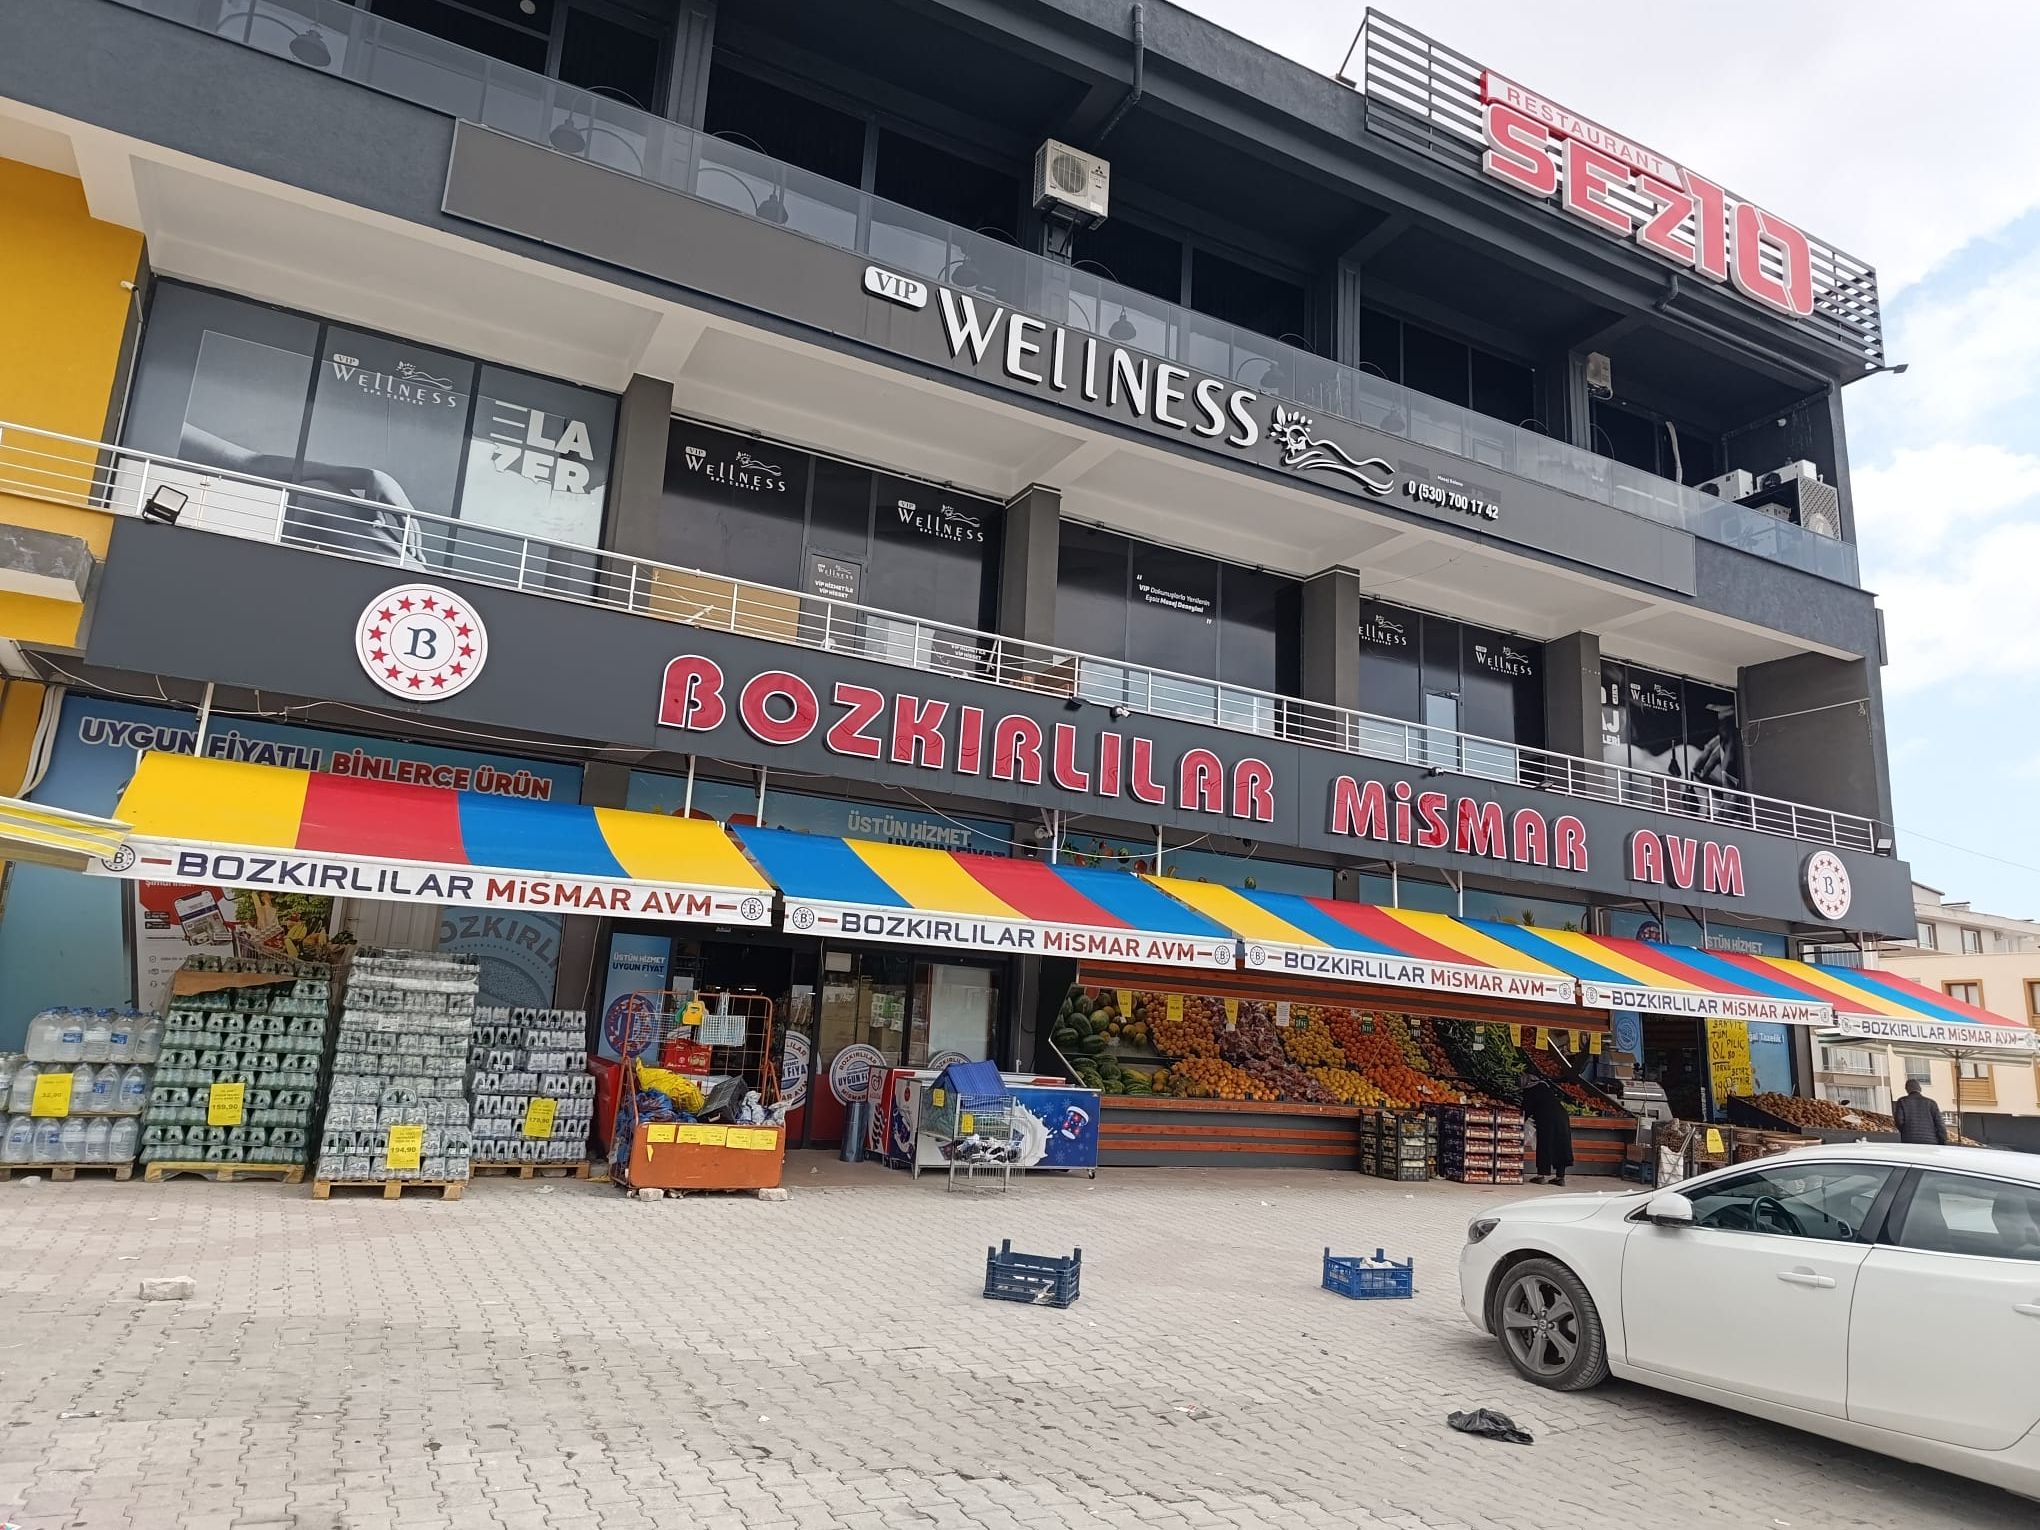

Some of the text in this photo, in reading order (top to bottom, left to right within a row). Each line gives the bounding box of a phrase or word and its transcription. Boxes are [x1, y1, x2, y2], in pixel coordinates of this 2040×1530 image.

[1507, 86, 1664, 176] RESTAURANT
[871, 270, 919, 301] VIP
[526, 409, 594, 461] LA
[1408, 480, 1499, 519] 0 (530) 700 17 42
[403, 626, 437, 660] B
[79, 716, 199, 755] UYGUN
[208, 730, 322, 772] FİYATLI
[474, 764, 553, 801] ÜRÜN
[657, 653, 1275, 824] BOZKIRLILAR
[1631, 828, 1746, 897] AVM
[847, 809, 972, 846] ÜSTÜN HİZMET
[176, 851, 474, 900] BOZKIRLILAR
[641, 890, 712, 917] AVM
[840, 912, 1035, 949] BOZKIRLILAR
[1146, 940, 1196, 963] AVM
[612, 962, 640, 971] UYGUN
[1284, 951, 1425, 984] BOZKIRLILAR
[1508, 978, 1544, 997] AVM
[1611, 990, 1718, 1015] BOZKIRLILAR
[1782, 1007, 1809, 1021] AVM
[1861, 1020, 1945, 1040] BOZKIRLILAR
[1995, 1031, 2017, 1045] AVM
[788, 1063, 808, 1078] FİYA
